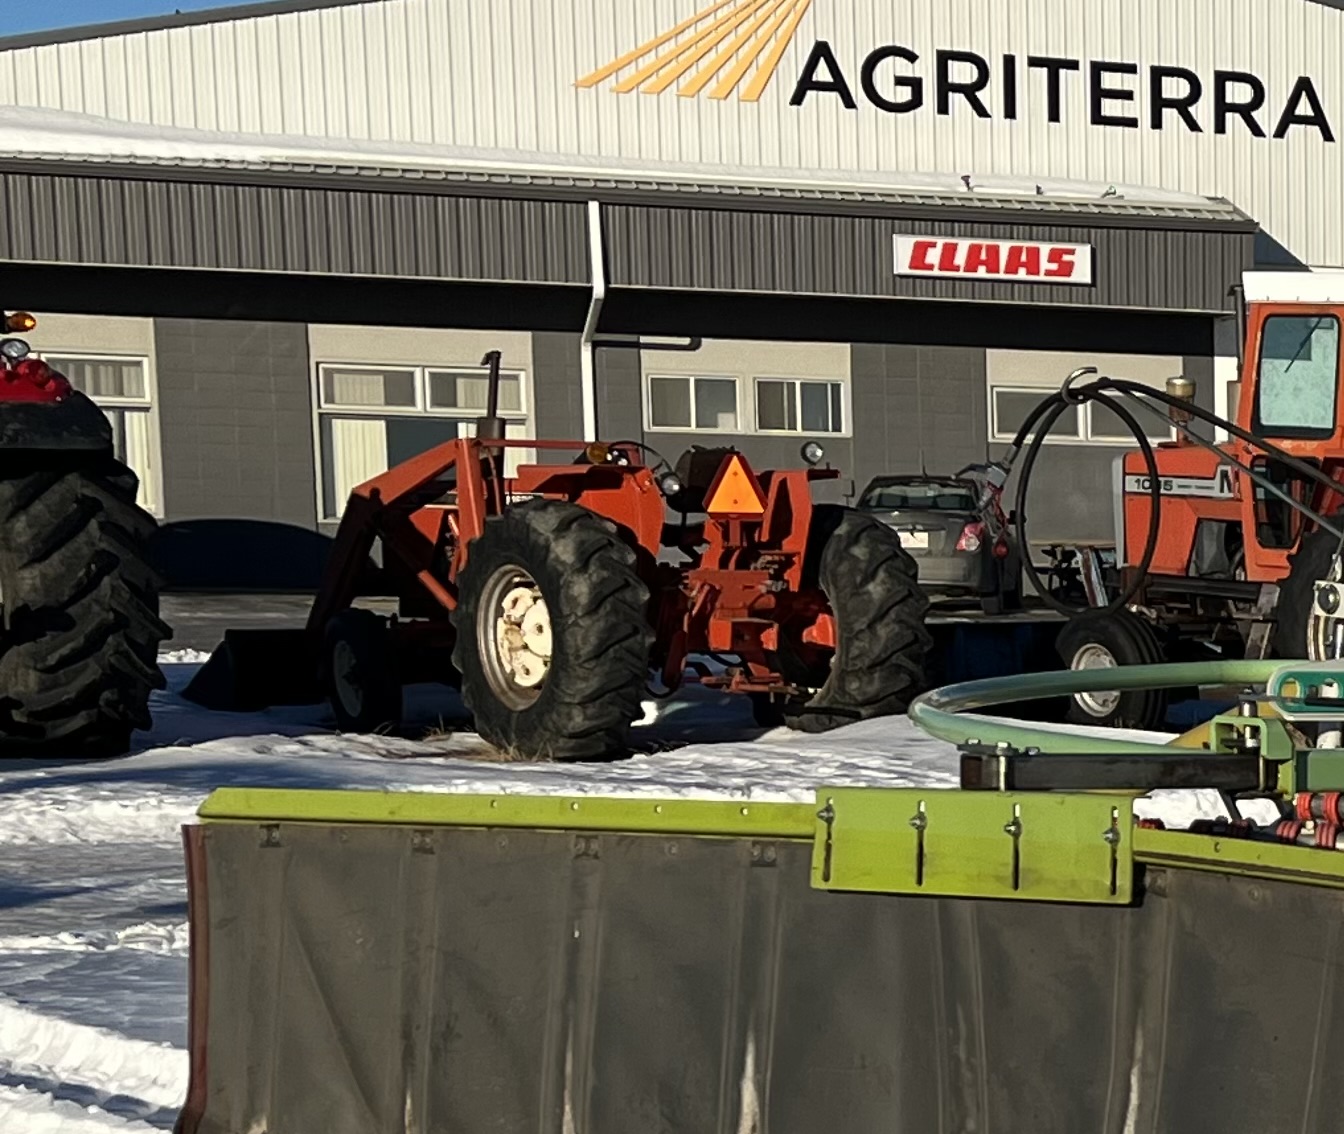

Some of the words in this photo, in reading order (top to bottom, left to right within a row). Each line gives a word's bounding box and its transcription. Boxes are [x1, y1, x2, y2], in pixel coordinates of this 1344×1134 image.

[789, 39, 1335, 142] AGRITERRA
[908, 240, 1077, 278] CLAAS
[1134, 477, 1173, 491] 105
